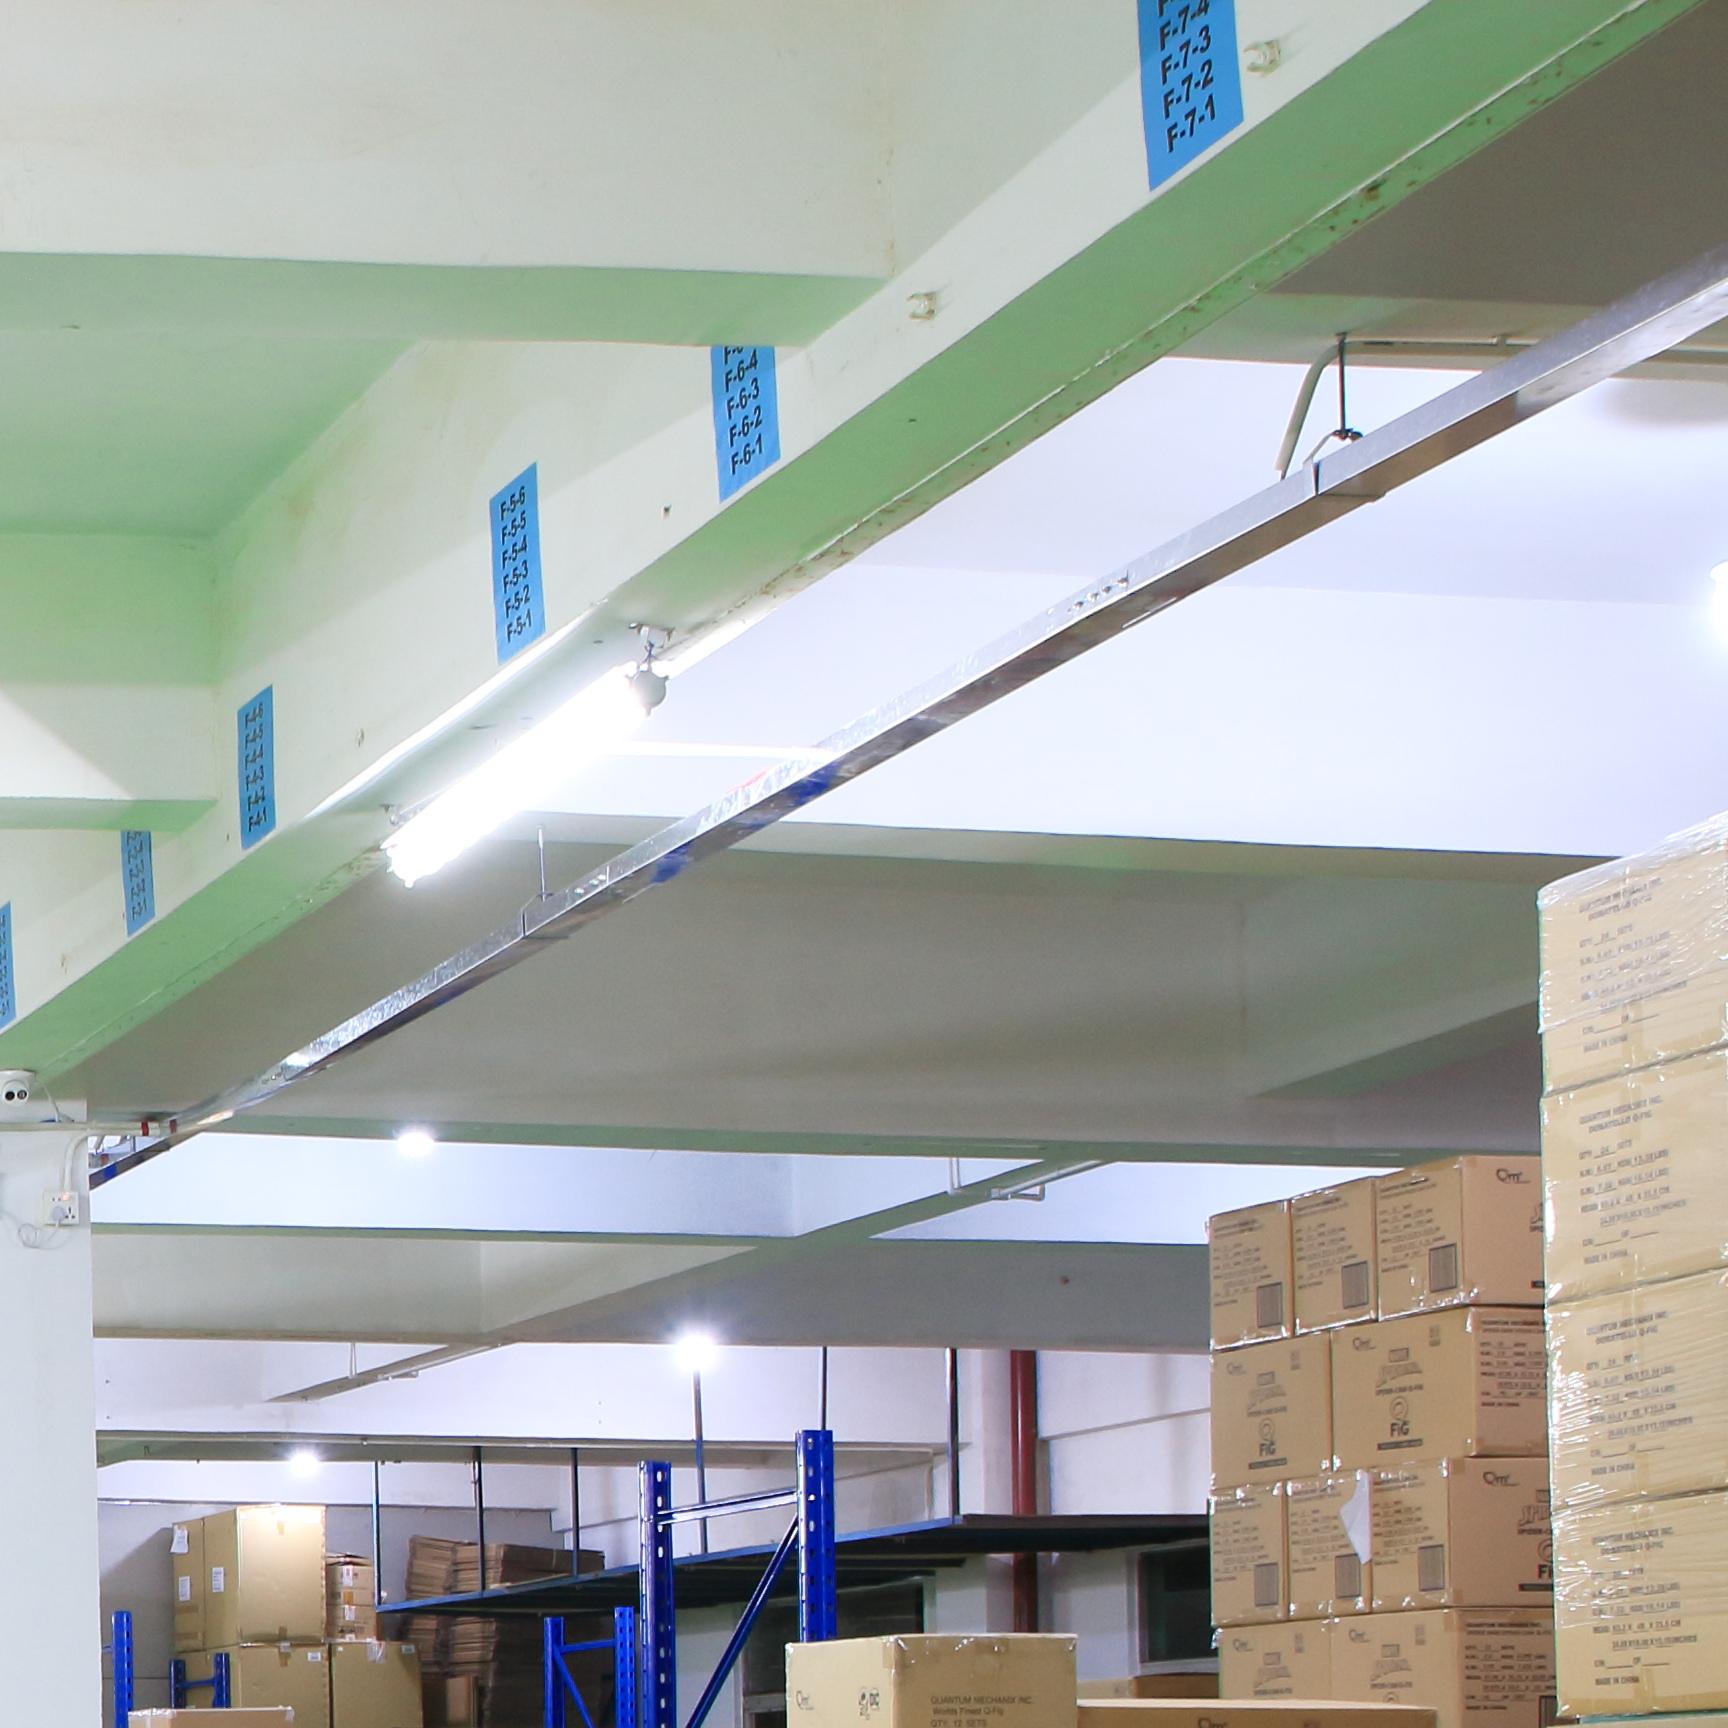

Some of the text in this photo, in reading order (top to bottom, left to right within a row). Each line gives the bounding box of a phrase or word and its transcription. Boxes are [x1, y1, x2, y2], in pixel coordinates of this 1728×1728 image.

[1159, 0, 1210, 51] F-7-4
[1161, 24, 1211, 86] F-7-3
[1163, 59, 1214, 120] F-7-2
[1167, 93, 1216, 153] F-7-1
[724, 348, 758, 393] F-6-4
[726, 377, 760, 420] F-6-3
[729, 405, 763, 448] F-6-2
[731, 433, 763, 475] F-6-1
[500, 485, 526, 521] F-5-6
[501, 510, 527, 545] F-5-5
[501, 534, 527, 569] F-5-4
[503, 559, 528, 594] F-5-3
[504, 584, 531, 619] F-5-2
[506, 608, 532, 643] F-5-1
